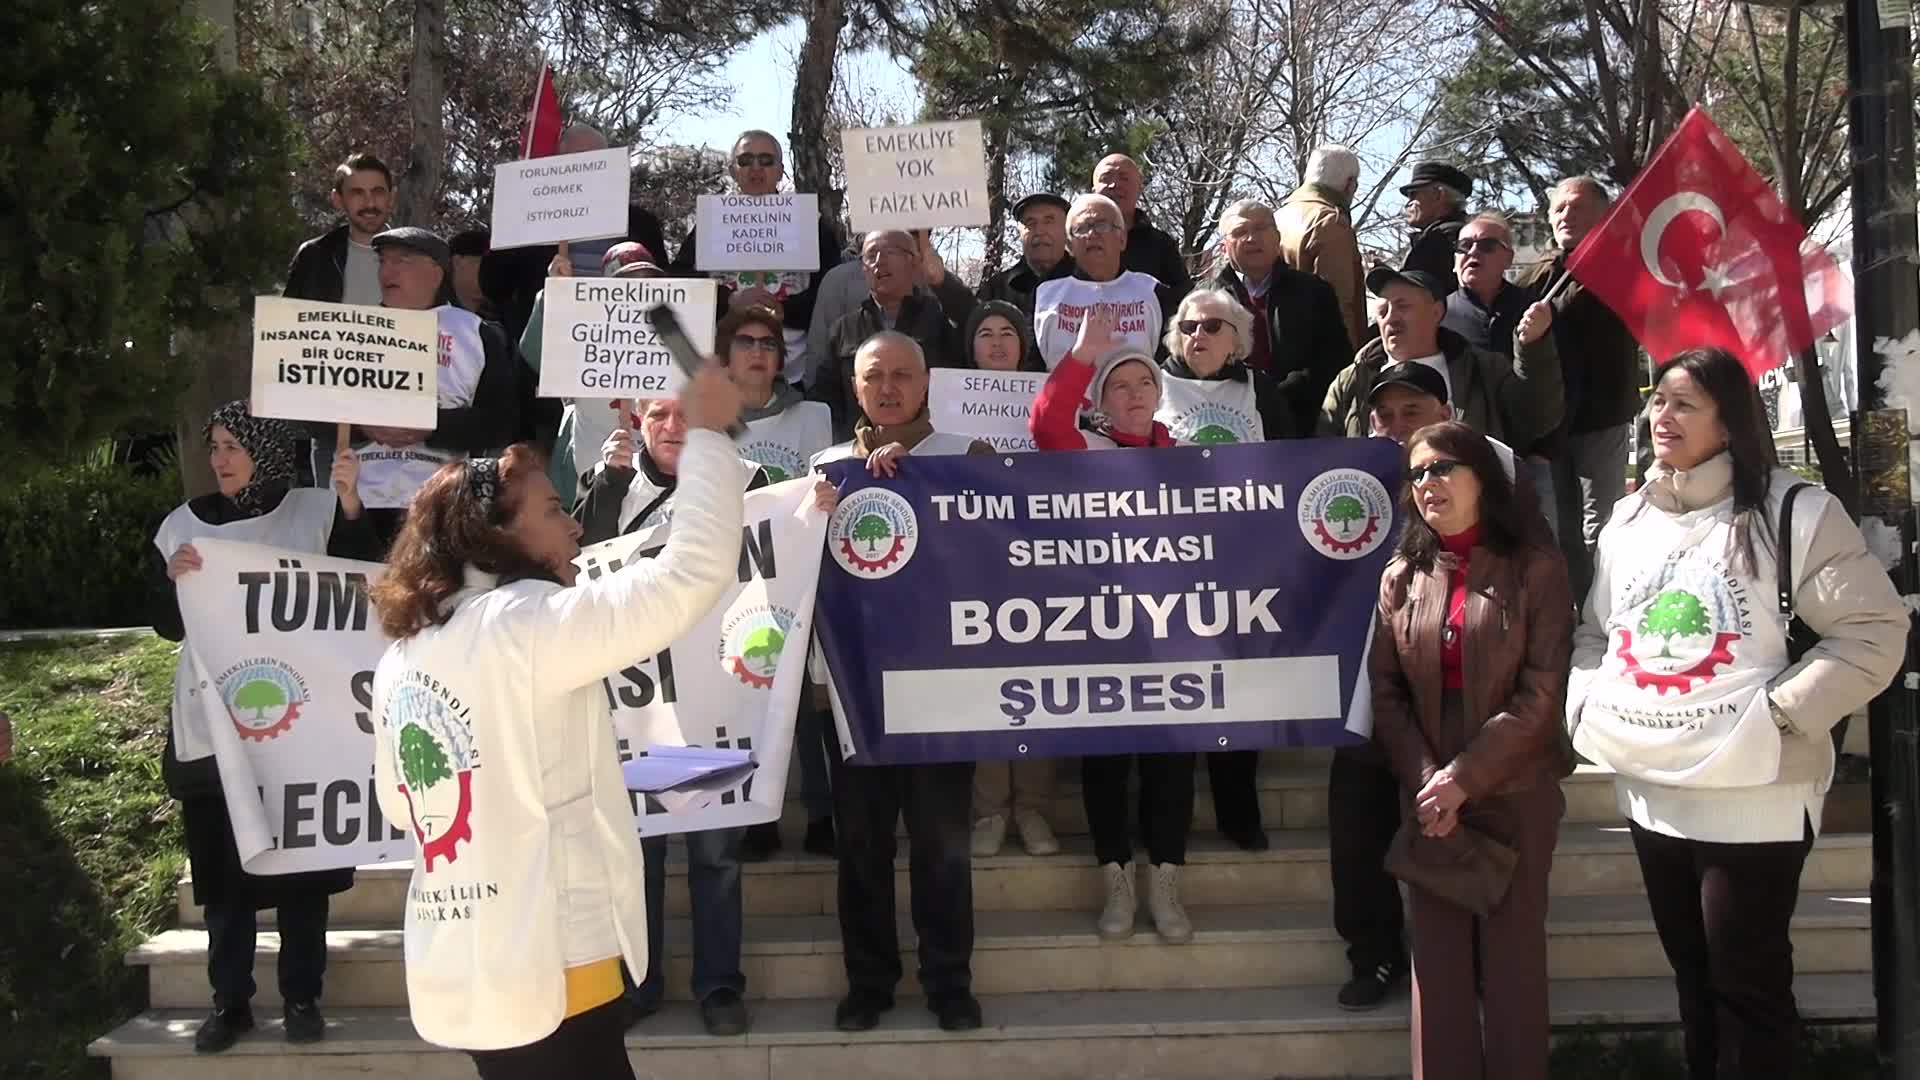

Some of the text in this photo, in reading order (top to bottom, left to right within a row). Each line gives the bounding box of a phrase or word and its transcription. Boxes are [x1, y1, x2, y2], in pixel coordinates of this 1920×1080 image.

[865, 128, 956, 153] EMEKLİYE
[520, 160, 608, 179] TORUNLARIMIZI
[896, 159, 935, 178] YOK
[720, 196, 793, 207] YOKSULLUK
[869, 191, 918, 214] FAİZE
[722, 212, 792, 224] EMEKLİNİN
[732, 228, 777, 239] KADERİ
[726, 241, 785, 254] DEĞİLDİR
[575, 282, 686, 303] Emeklinin
[298, 310, 396, 330] EMEKLİLERE
[337, 330, 429, 353] YAŞANACAK
[302, 346, 385, 363] BİR ÜCRET
[584, 344, 671, 368] Bayram
[278, 358, 410, 391] İSTİYORUZ
[581, 367, 668, 390] Gelmez
[964, 377, 1037, 394] SEFALETE
[931, 479, 1285, 521] TÜM EMEKLİLERİN
[1008, 532, 1214, 567] SENDİKASI
[238, 559, 370, 634] TÜM
[950, 581, 1282, 646] BOZÜYÜK
[1000, 664, 1226, 726] ŞUBESİ
